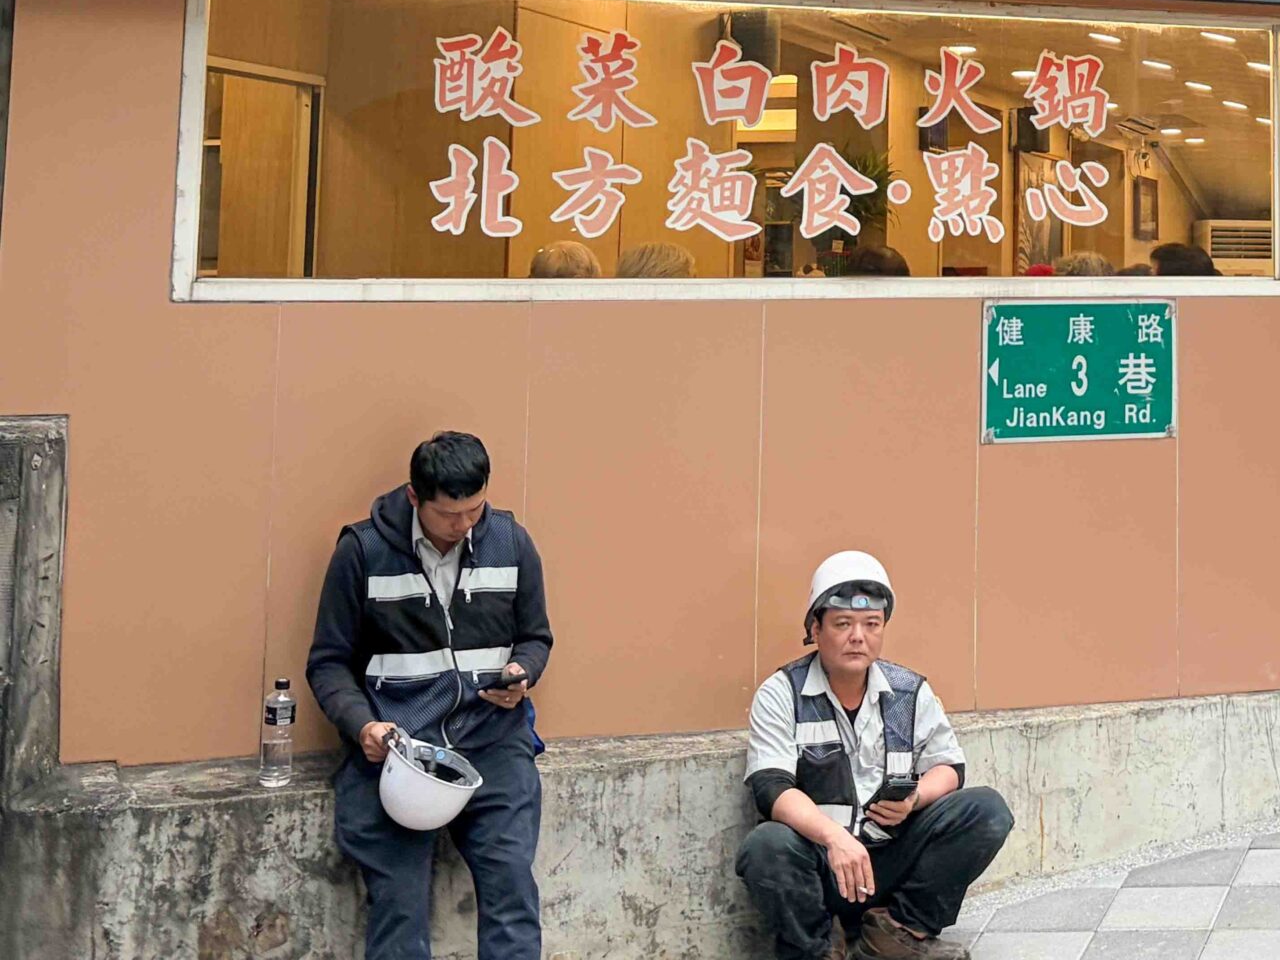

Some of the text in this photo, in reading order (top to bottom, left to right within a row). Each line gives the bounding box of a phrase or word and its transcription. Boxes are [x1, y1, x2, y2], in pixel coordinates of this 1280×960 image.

[433, 26, 1110, 137] 酸菜白肉火鍋
[996, 313, 1165, 347] 健康路
[1003, 352, 1158, 399] Lane 3 巷
[1006, 402, 1156, 429] JianKang Rd.
